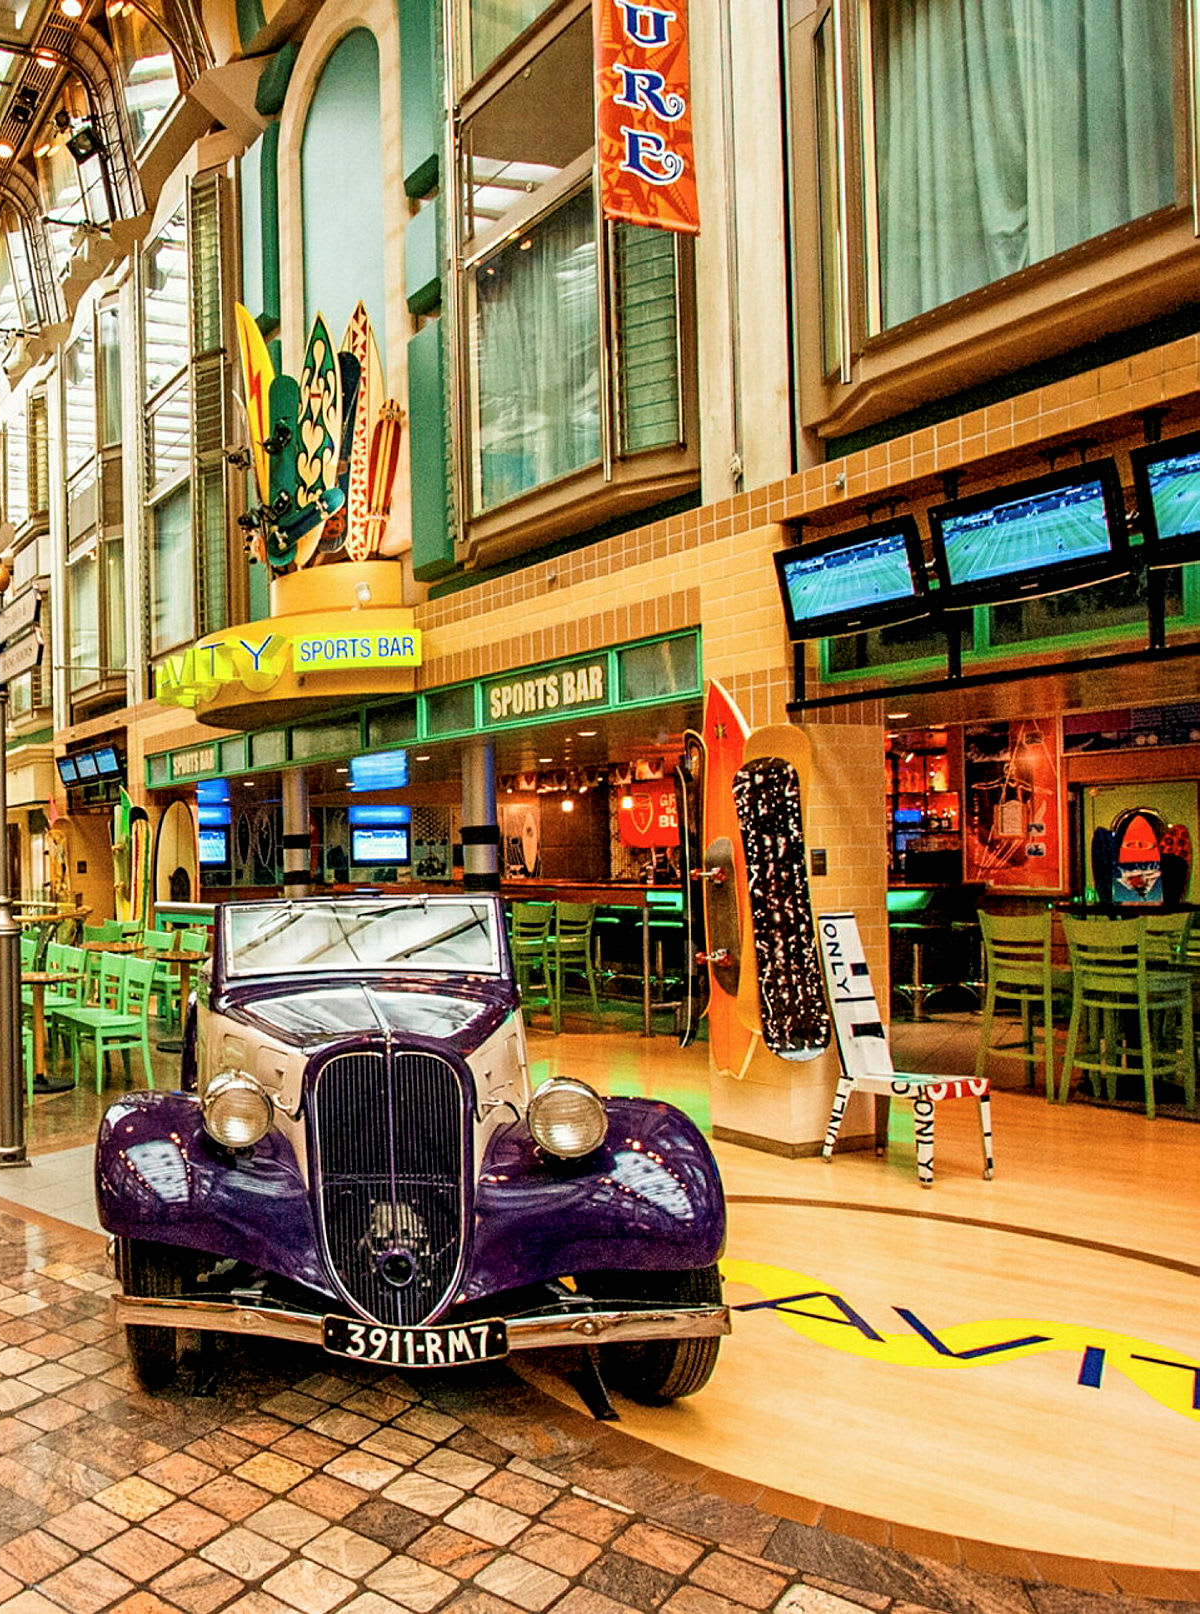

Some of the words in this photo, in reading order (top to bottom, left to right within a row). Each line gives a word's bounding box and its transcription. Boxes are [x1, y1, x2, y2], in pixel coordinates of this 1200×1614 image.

[300, 638, 372, 662] SPORTS
[378, 636, 415, 657] BAR
[490, 674, 559, 719] SPORTS
[562, 665, 603, 705] BAR
[823, 923, 852, 994] ONLY
[914, 1099, 934, 1171] ONLY
[345, 1323, 490, 1364] 3911-RM7
